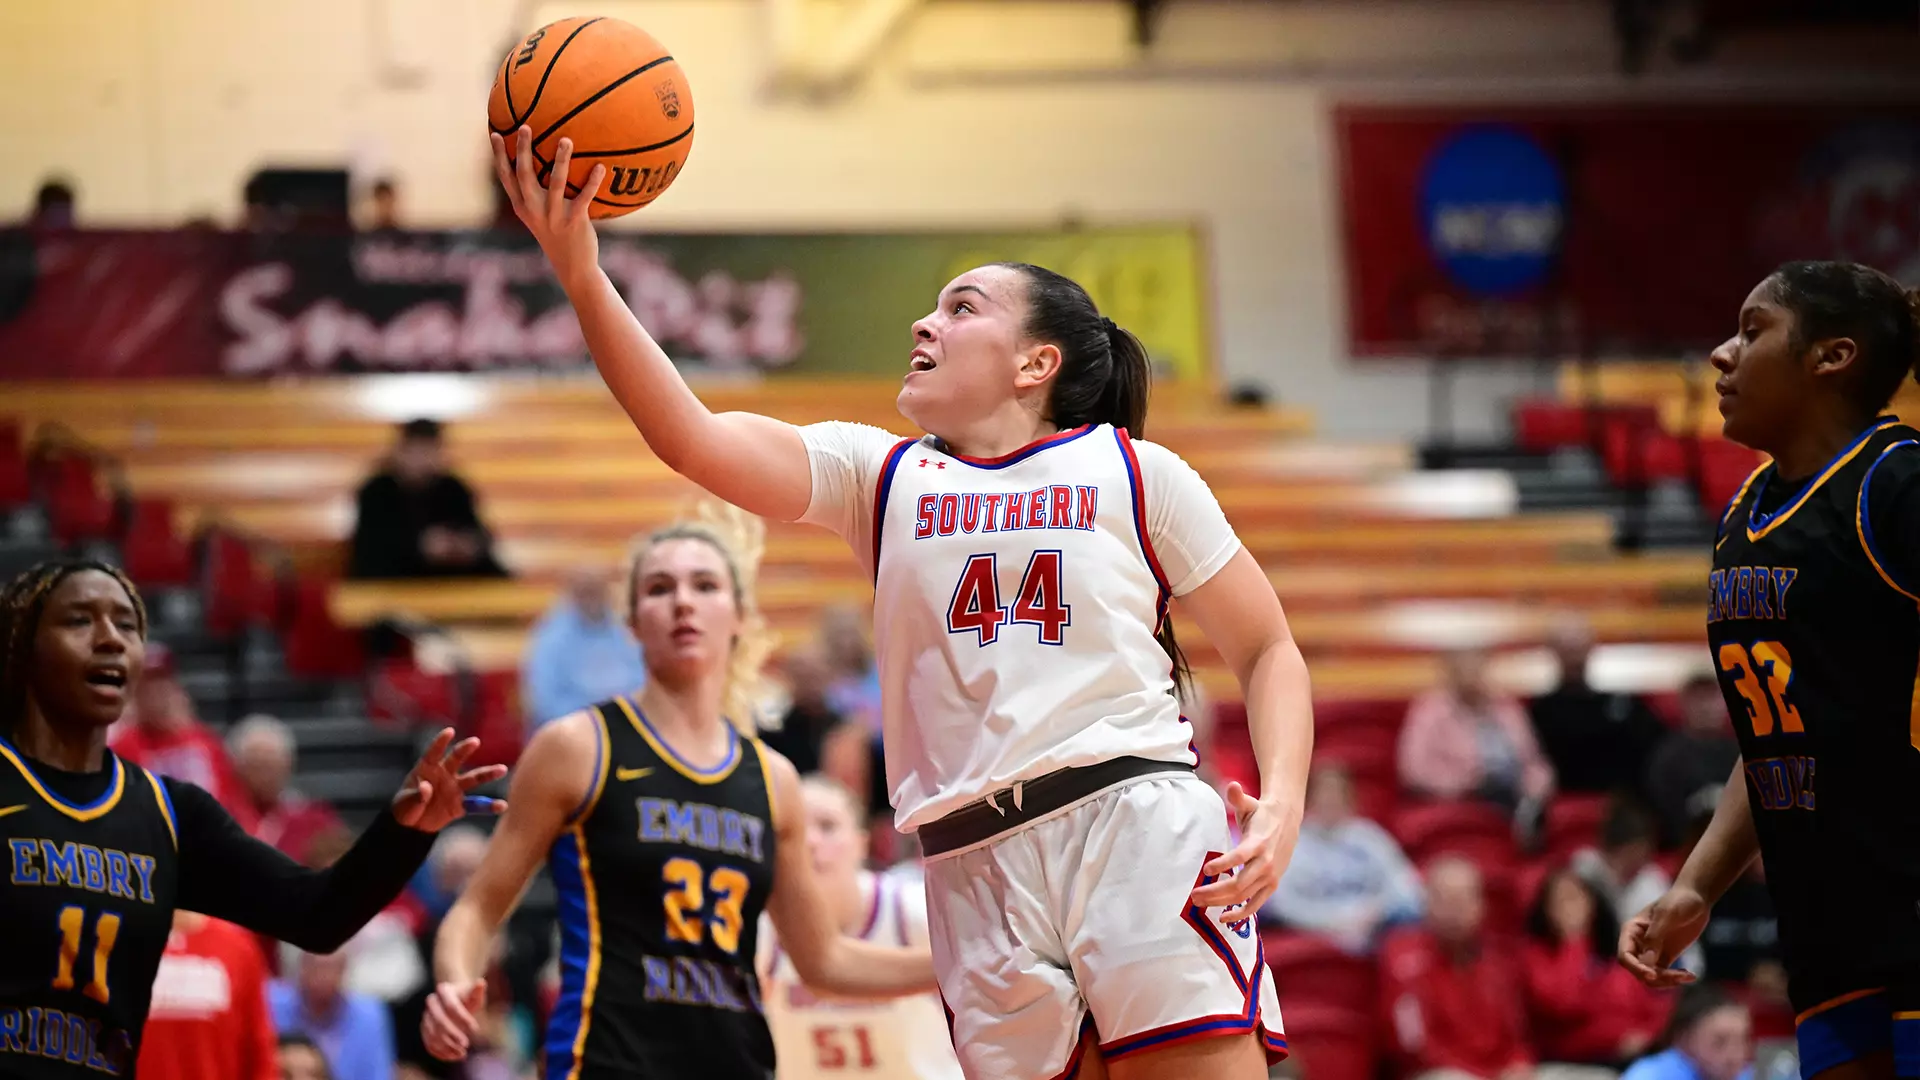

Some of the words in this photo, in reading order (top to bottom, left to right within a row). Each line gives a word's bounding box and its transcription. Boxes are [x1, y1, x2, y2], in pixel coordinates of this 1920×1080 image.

[609, 160, 679, 196] Wil
[915, 485, 1098, 540] SOUTHERN
[946, 549, 1071, 648] 44
[1707, 565, 1798, 624] EMBRY
[1718, 637, 1806, 738] 32
[636, 797, 764, 862] EMBRY
[8, 838, 156, 904] EMBRY
[662, 856, 750, 955] 23
[52, 903, 122, 1005] 11
[810, 1022, 878, 1071] 51
